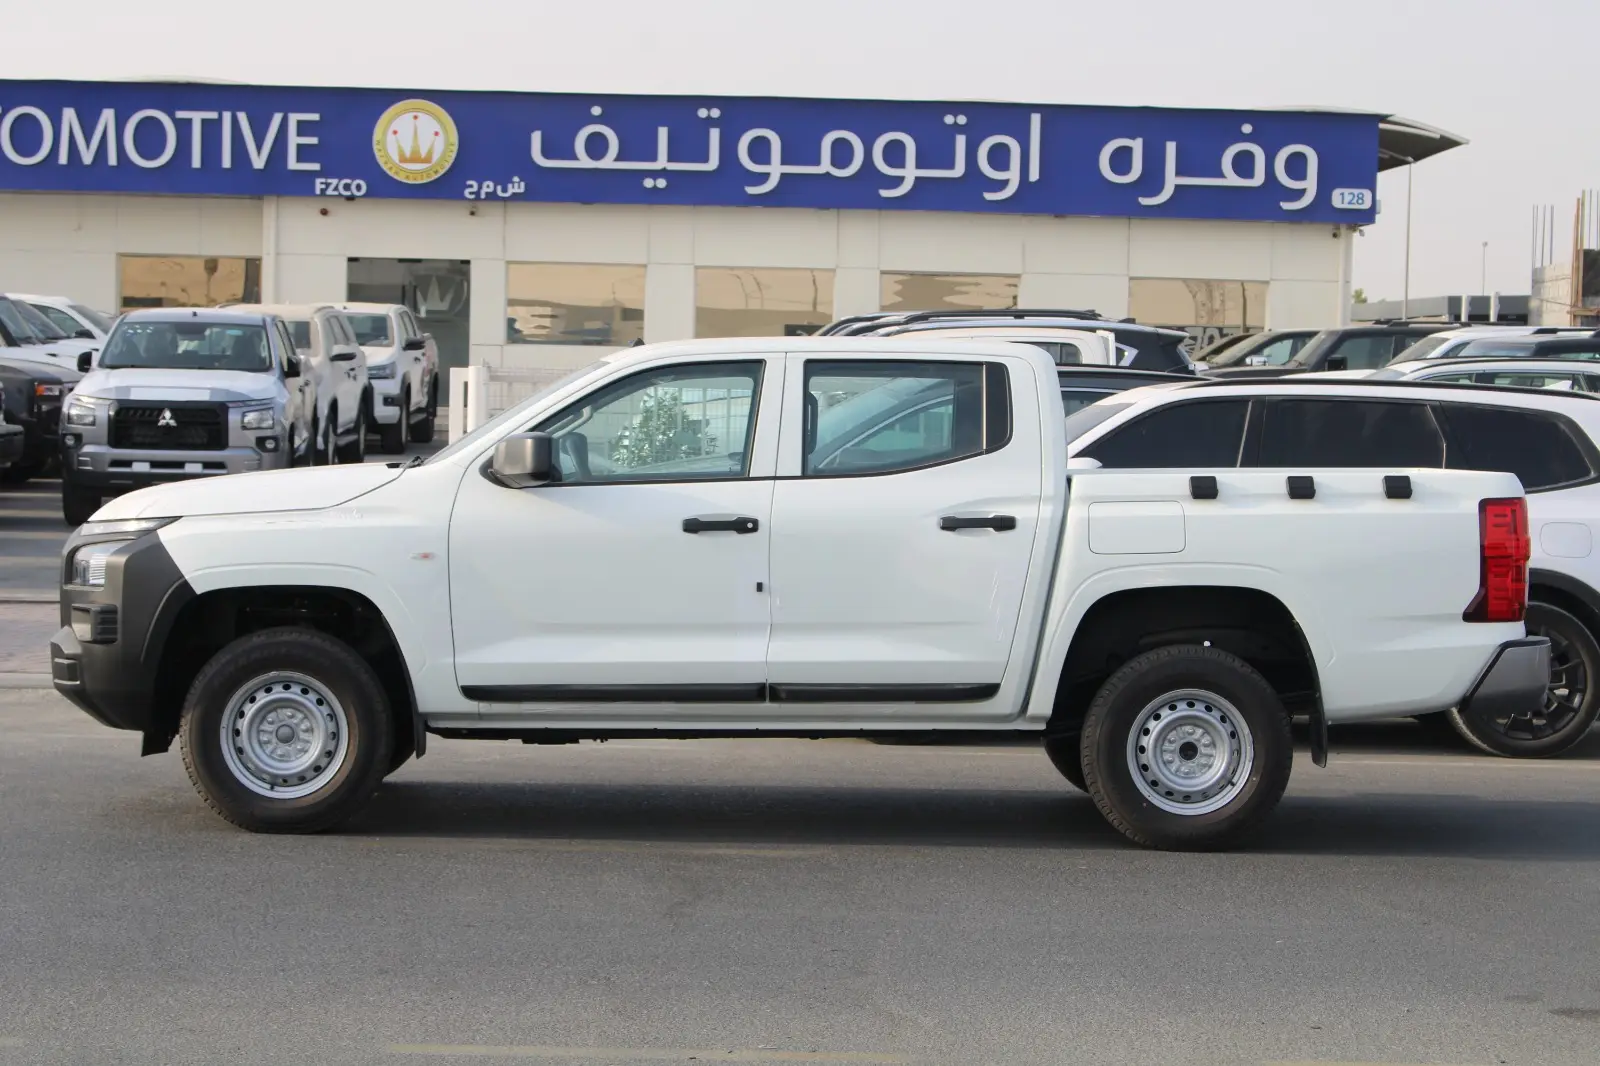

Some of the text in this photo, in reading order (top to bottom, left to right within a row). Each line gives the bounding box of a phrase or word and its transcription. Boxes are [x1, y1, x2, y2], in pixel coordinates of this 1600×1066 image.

[0, 105, 321, 171] OMOTIVE
[530, 105, 1319, 210] وفره اوتوموتيف
[315, 178, 367, 196] FZCO
[1339, 191, 1365, 206] 128
